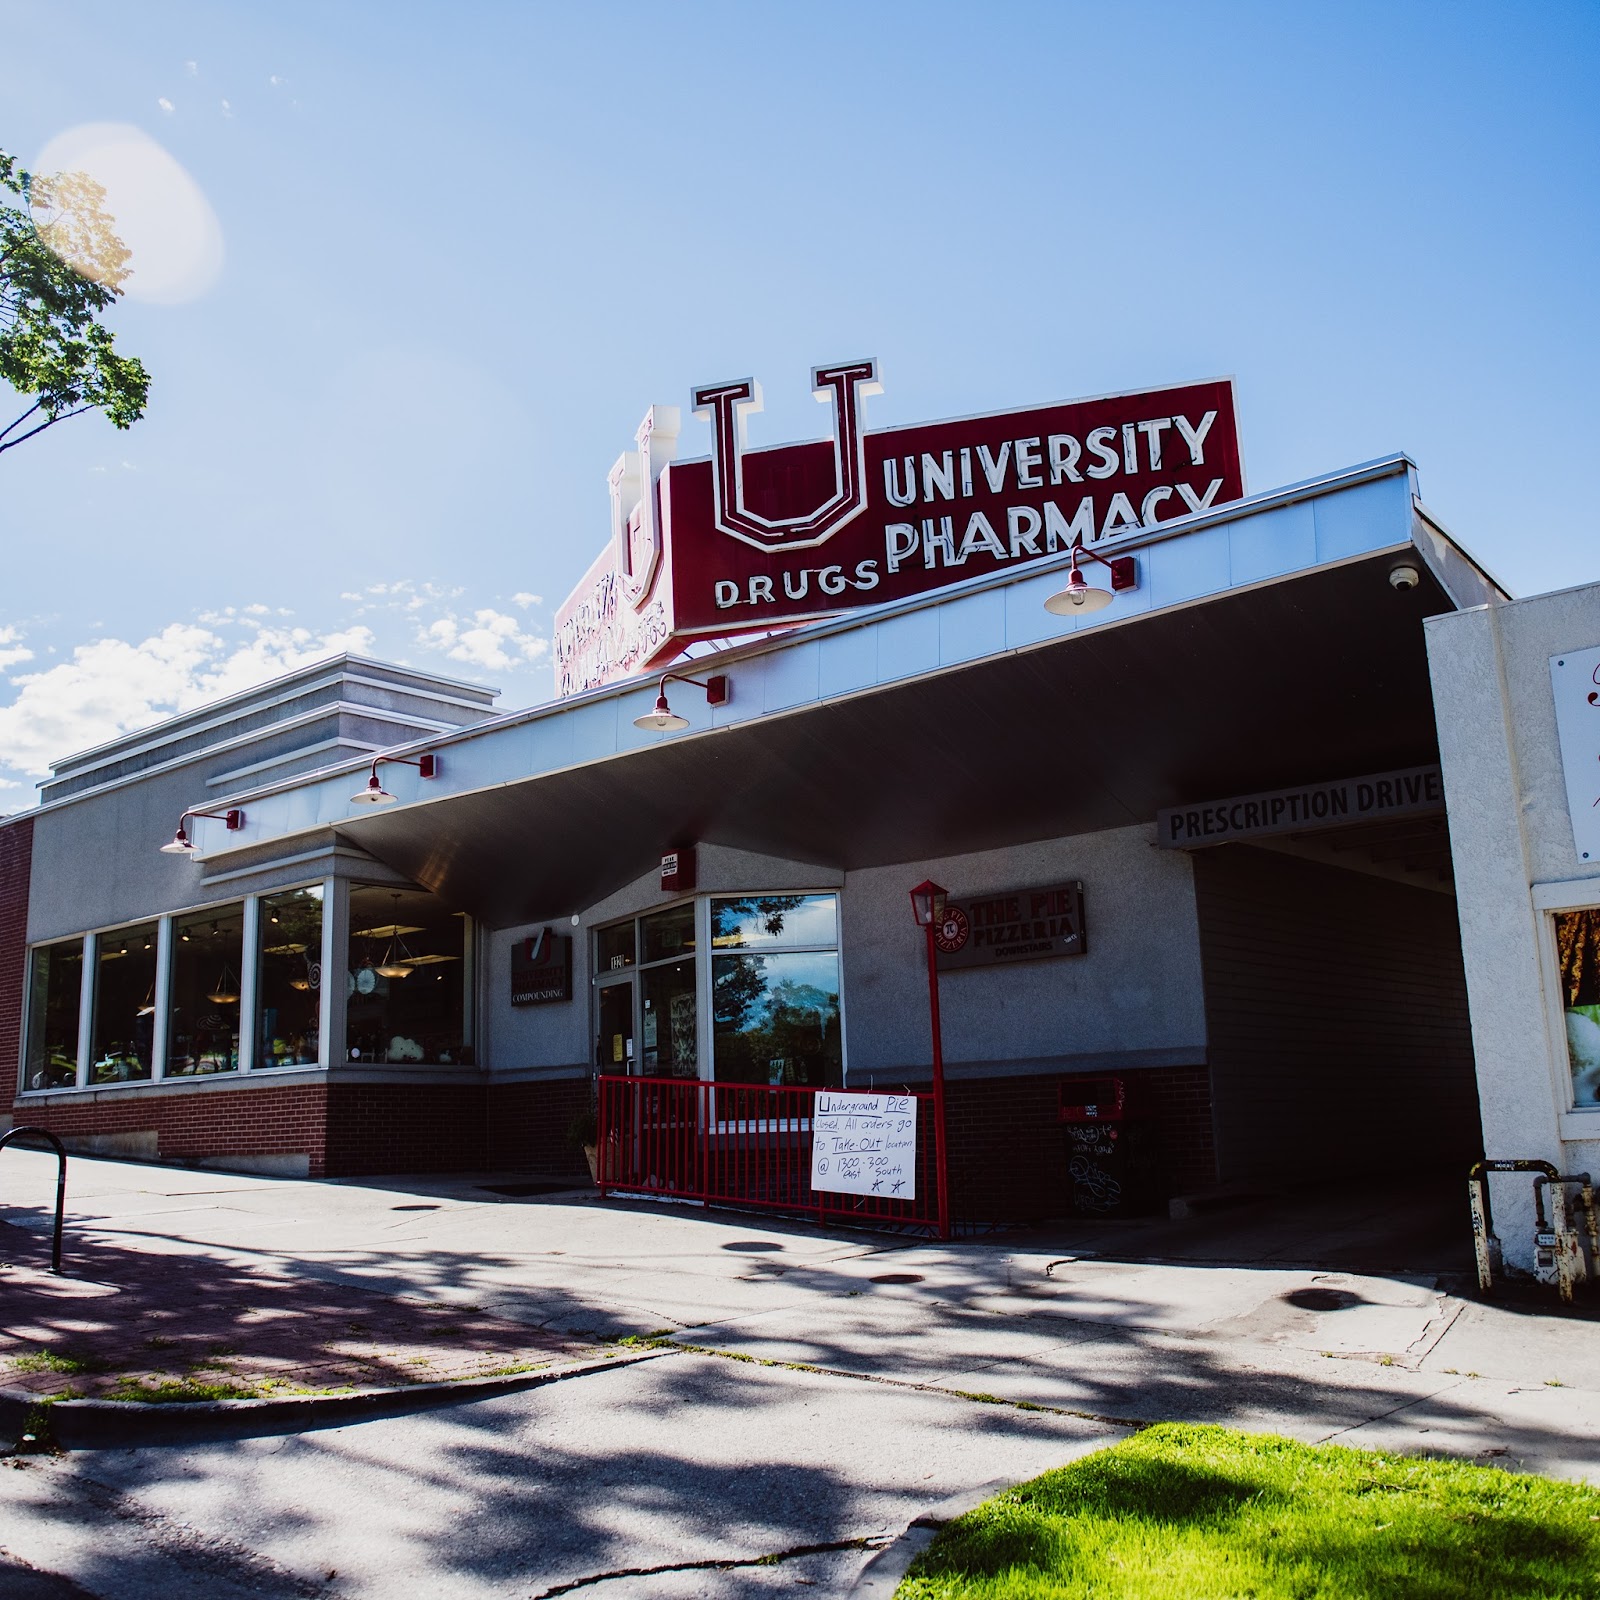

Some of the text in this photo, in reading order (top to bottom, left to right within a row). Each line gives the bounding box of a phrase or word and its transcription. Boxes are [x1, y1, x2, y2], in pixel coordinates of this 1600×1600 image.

[691, 357, 879, 553] U
[882, 410, 1218, 508] UNIVERSITY
[714, 560, 880, 609] DRUGS
[1170, 772, 1439, 840] PRESCRIPTION DRIVE
[969, 889, 1073, 927] THE PIE
[973, 917, 1074, 947] PIZZERIA
[995, 940, 1054, 957] DOWNSTAIRS
[512, 988, 563, 1003] COMPOUNDING
[819, 1095, 879, 1114] Underground
[845, 1119, 857, 1131] All
[861, 1119, 893, 1130] orders
[897, 1119, 912, 1133] go
[816, 1136, 826, 1151] to
[831, 1136, 883, 1151] Take-Out
[842, 1168, 862, 1179] east
